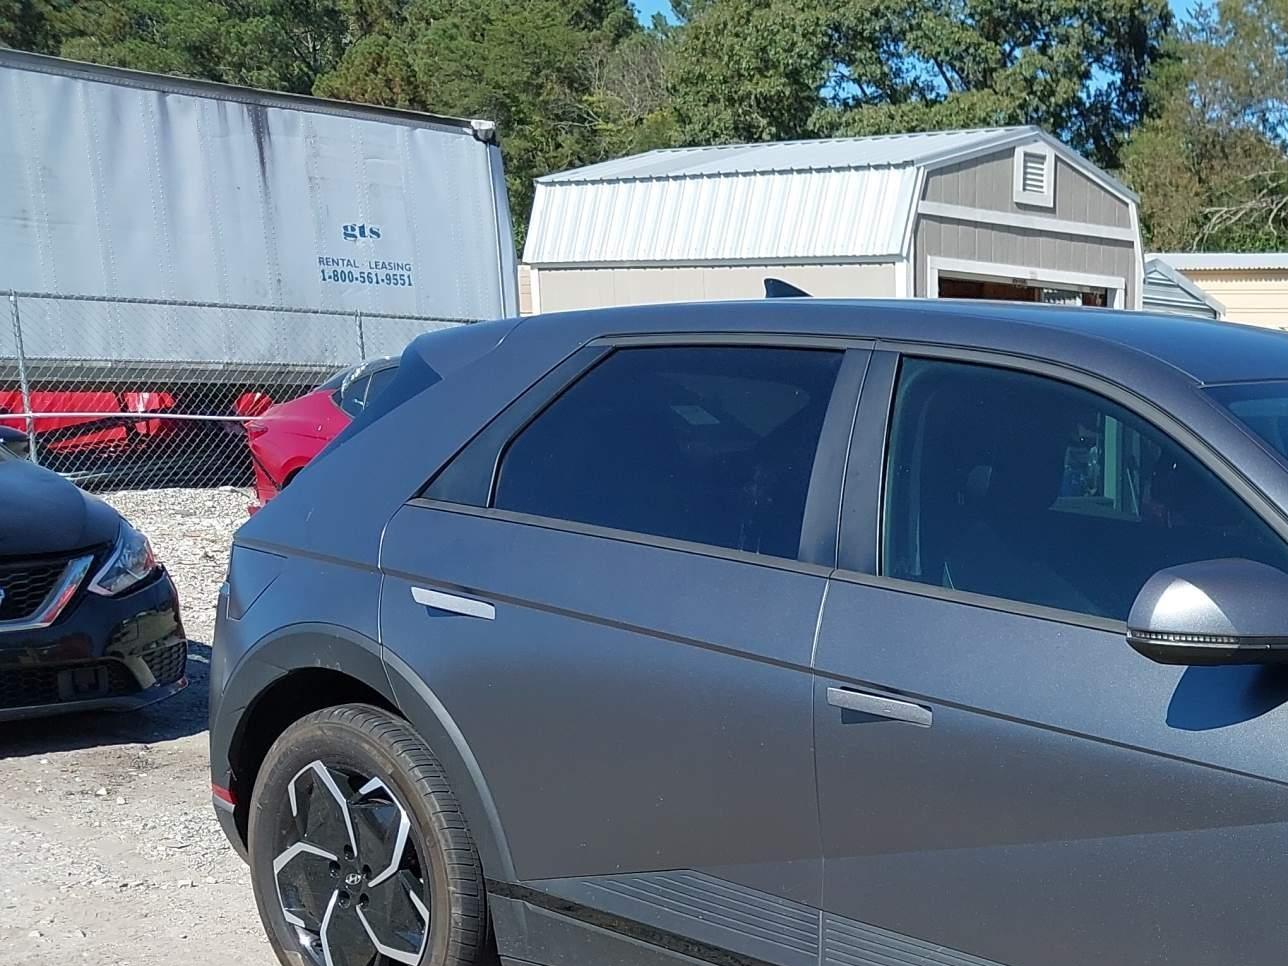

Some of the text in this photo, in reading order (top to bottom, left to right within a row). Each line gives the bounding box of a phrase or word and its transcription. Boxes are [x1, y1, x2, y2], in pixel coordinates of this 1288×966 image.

[342, 224, 381, 241] gts
[318, 257, 412, 272] RENTAL LEASING
[320, 270, 413, 287] 1-800-561-9551
